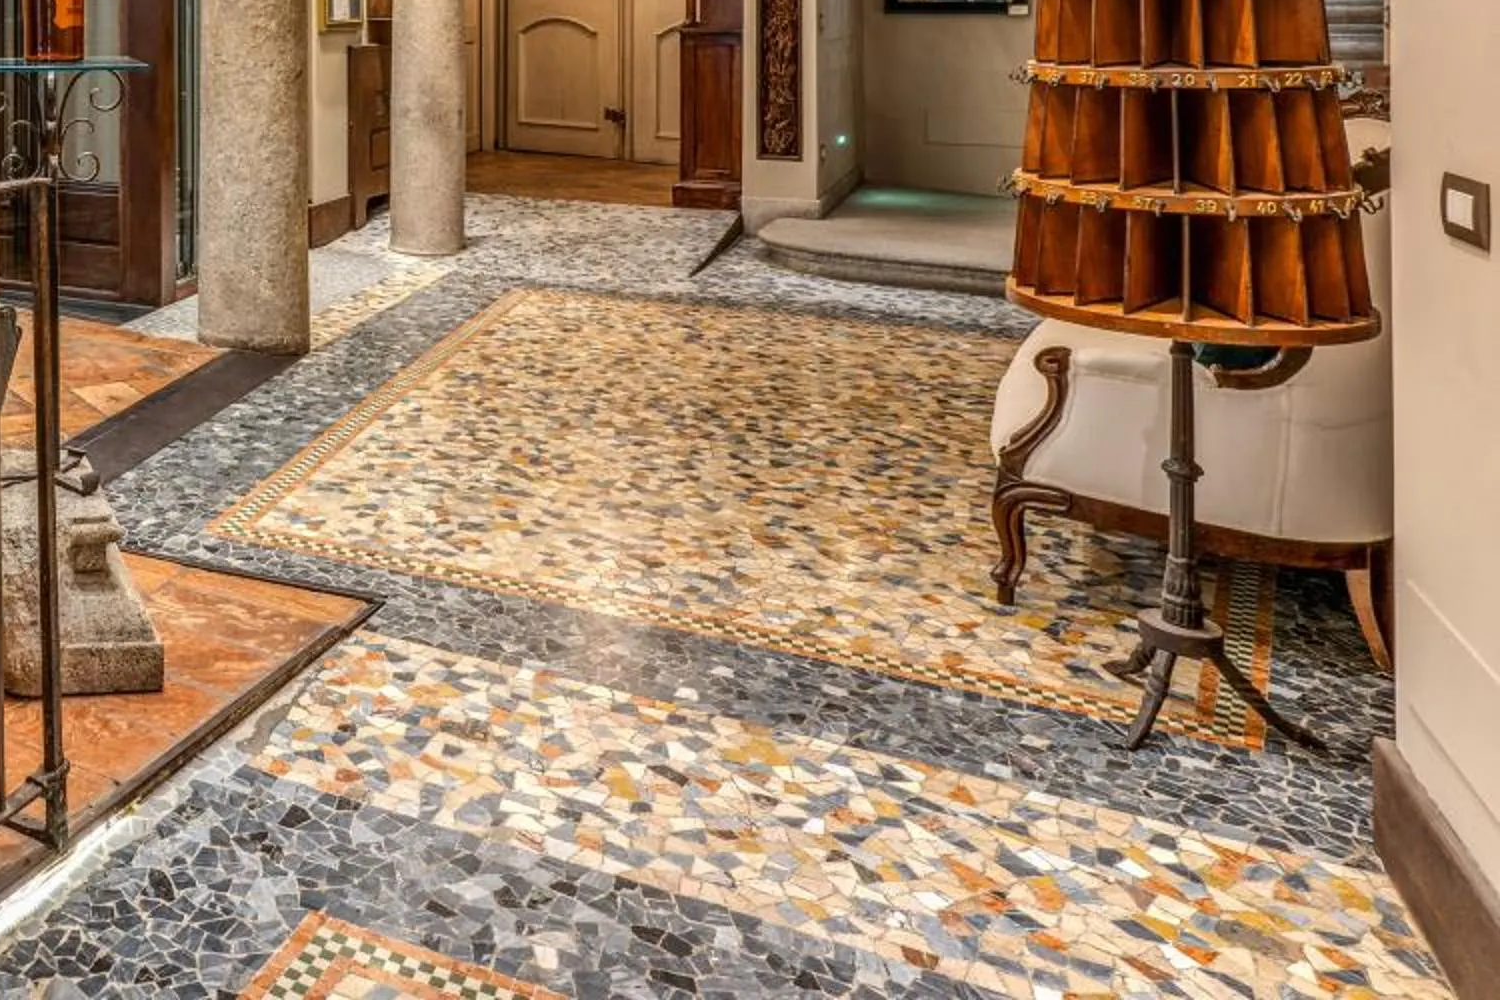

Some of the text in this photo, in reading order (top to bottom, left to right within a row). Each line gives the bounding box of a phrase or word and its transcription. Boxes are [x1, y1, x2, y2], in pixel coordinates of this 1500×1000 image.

[1171, 73, 1196, 87] 20
[1237, 74, 1257, 88] 21
[1195, 199, 1217, 213] 39
[1257, 201, 1277, 215] 40
